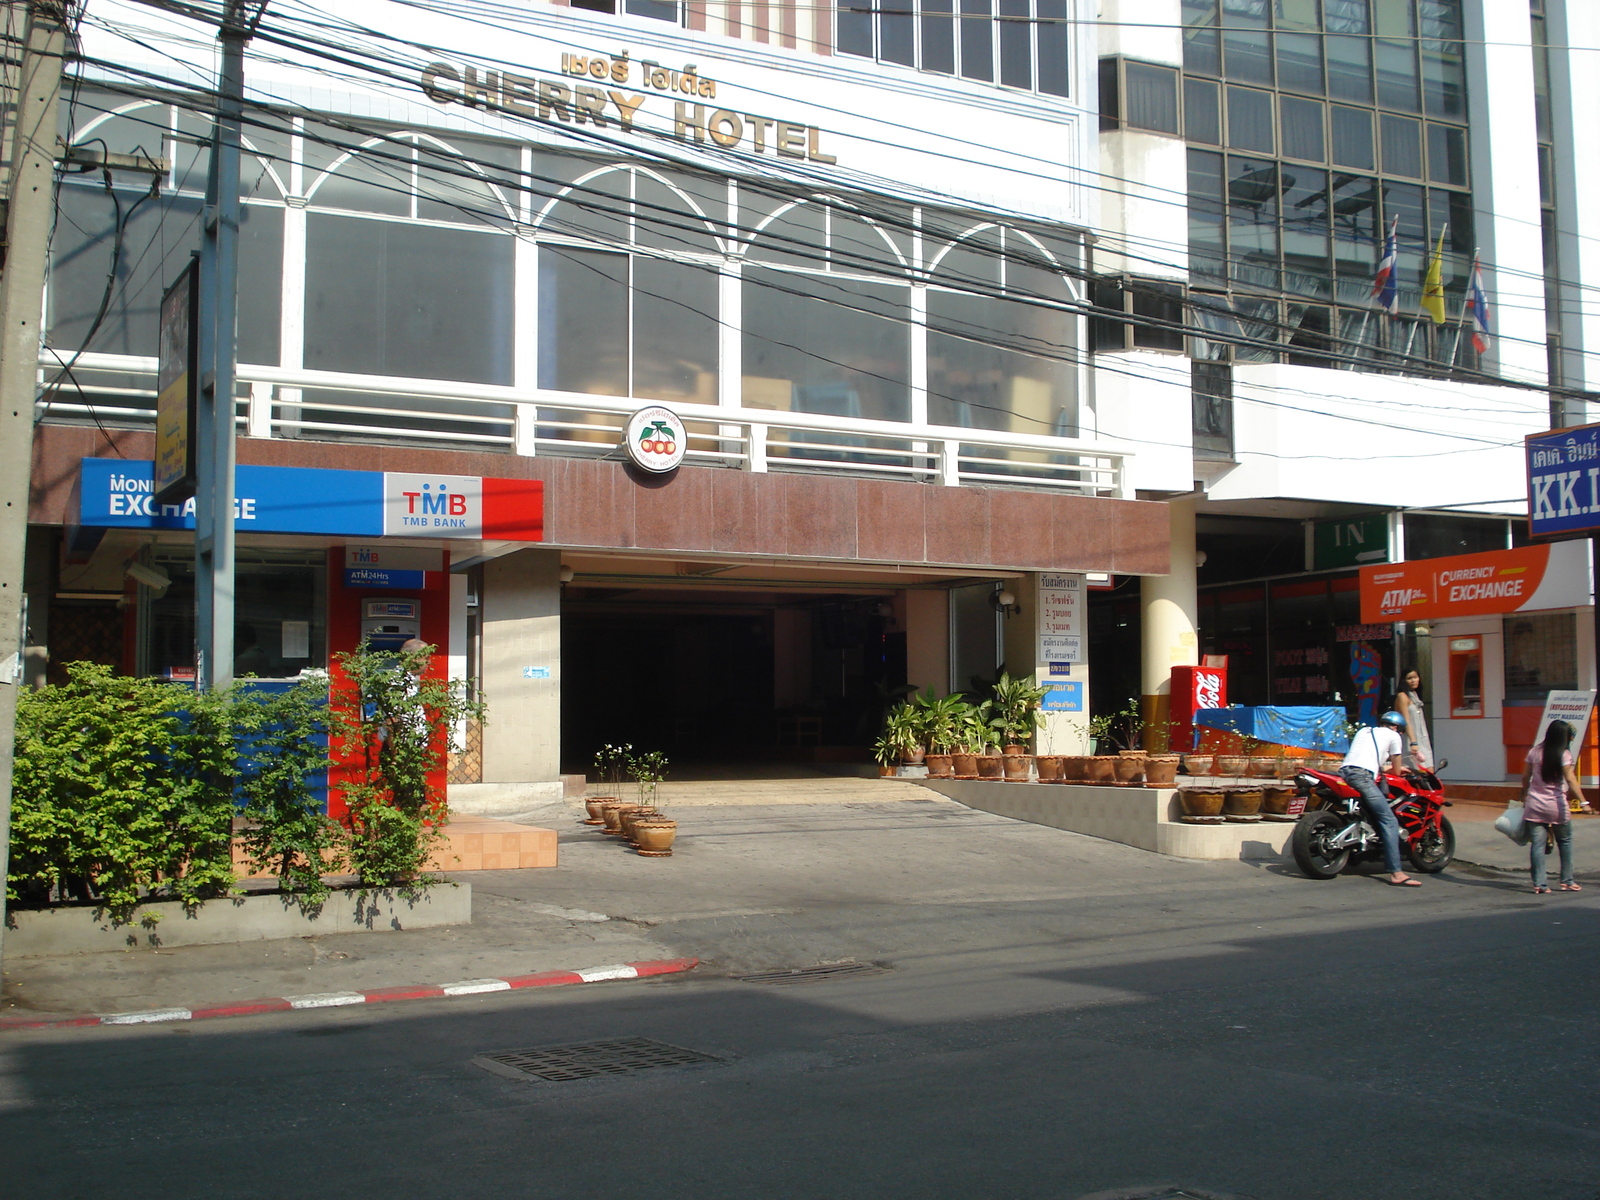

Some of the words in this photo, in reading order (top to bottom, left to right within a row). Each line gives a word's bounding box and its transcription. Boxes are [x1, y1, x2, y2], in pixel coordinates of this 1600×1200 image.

[421, 62, 645, 133] CHERRY
[674, 101, 837, 165] HOTEL
[402, 483, 467, 516] TMB
[402, 516, 428, 527] TMB
[434, 518, 467, 528] BANK
[1334, 521, 1365, 547] IN
[351, 549, 379, 563] TMB
[1439, 566, 1495, 587] CURRENCY
[1380, 589, 1412, 608] ATM
[1449, 579, 1524, 602] EXCHANGE
[1336, 623, 1392, 642] MASSAGE
[1274, 649, 1304, 666] FOOT
[1274, 677, 1301, 694] THAI
